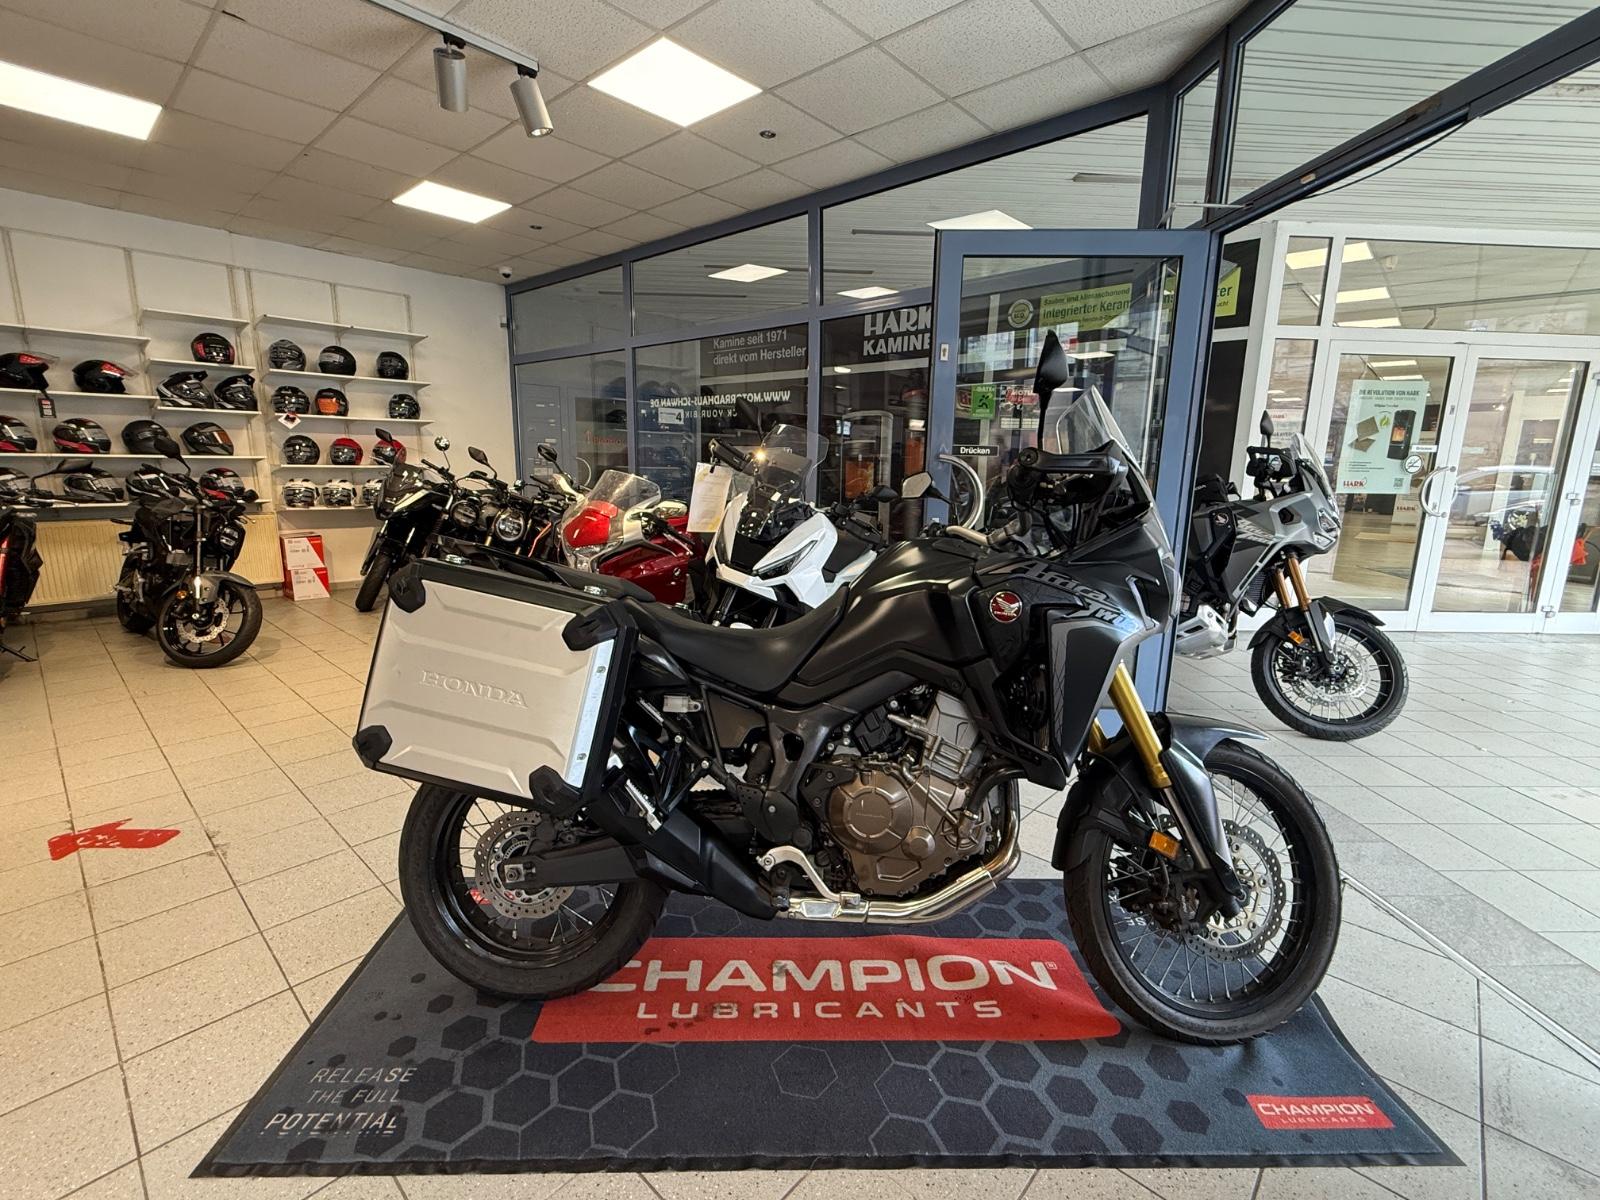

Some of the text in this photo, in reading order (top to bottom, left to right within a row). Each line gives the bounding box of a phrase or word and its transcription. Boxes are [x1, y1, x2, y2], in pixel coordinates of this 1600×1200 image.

[864, 306, 932, 336] HARK
[713, 328, 788, 349] Kamine seit 1971
[863, 333, 930, 356] KAMINE
[713, 345, 807, 365] direkt vom Hersteller
[960, 446, 991, 455] Drücken
[420, 669, 529, 709] HONDA
[586, 954, 1058, 992] CHAMPION
[636, 999, 1003, 1019] LUBRICANTS
[308, 1067, 418, 1083] RELEASE
[306, 1088, 400, 1104] THE FULL
[1257, 1102, 1375, 1116] CHAMPION
[264, 1112, 398, 1130] POTENTIAL
[1282, 1116, 1367, 1124] LUBRICANTS
